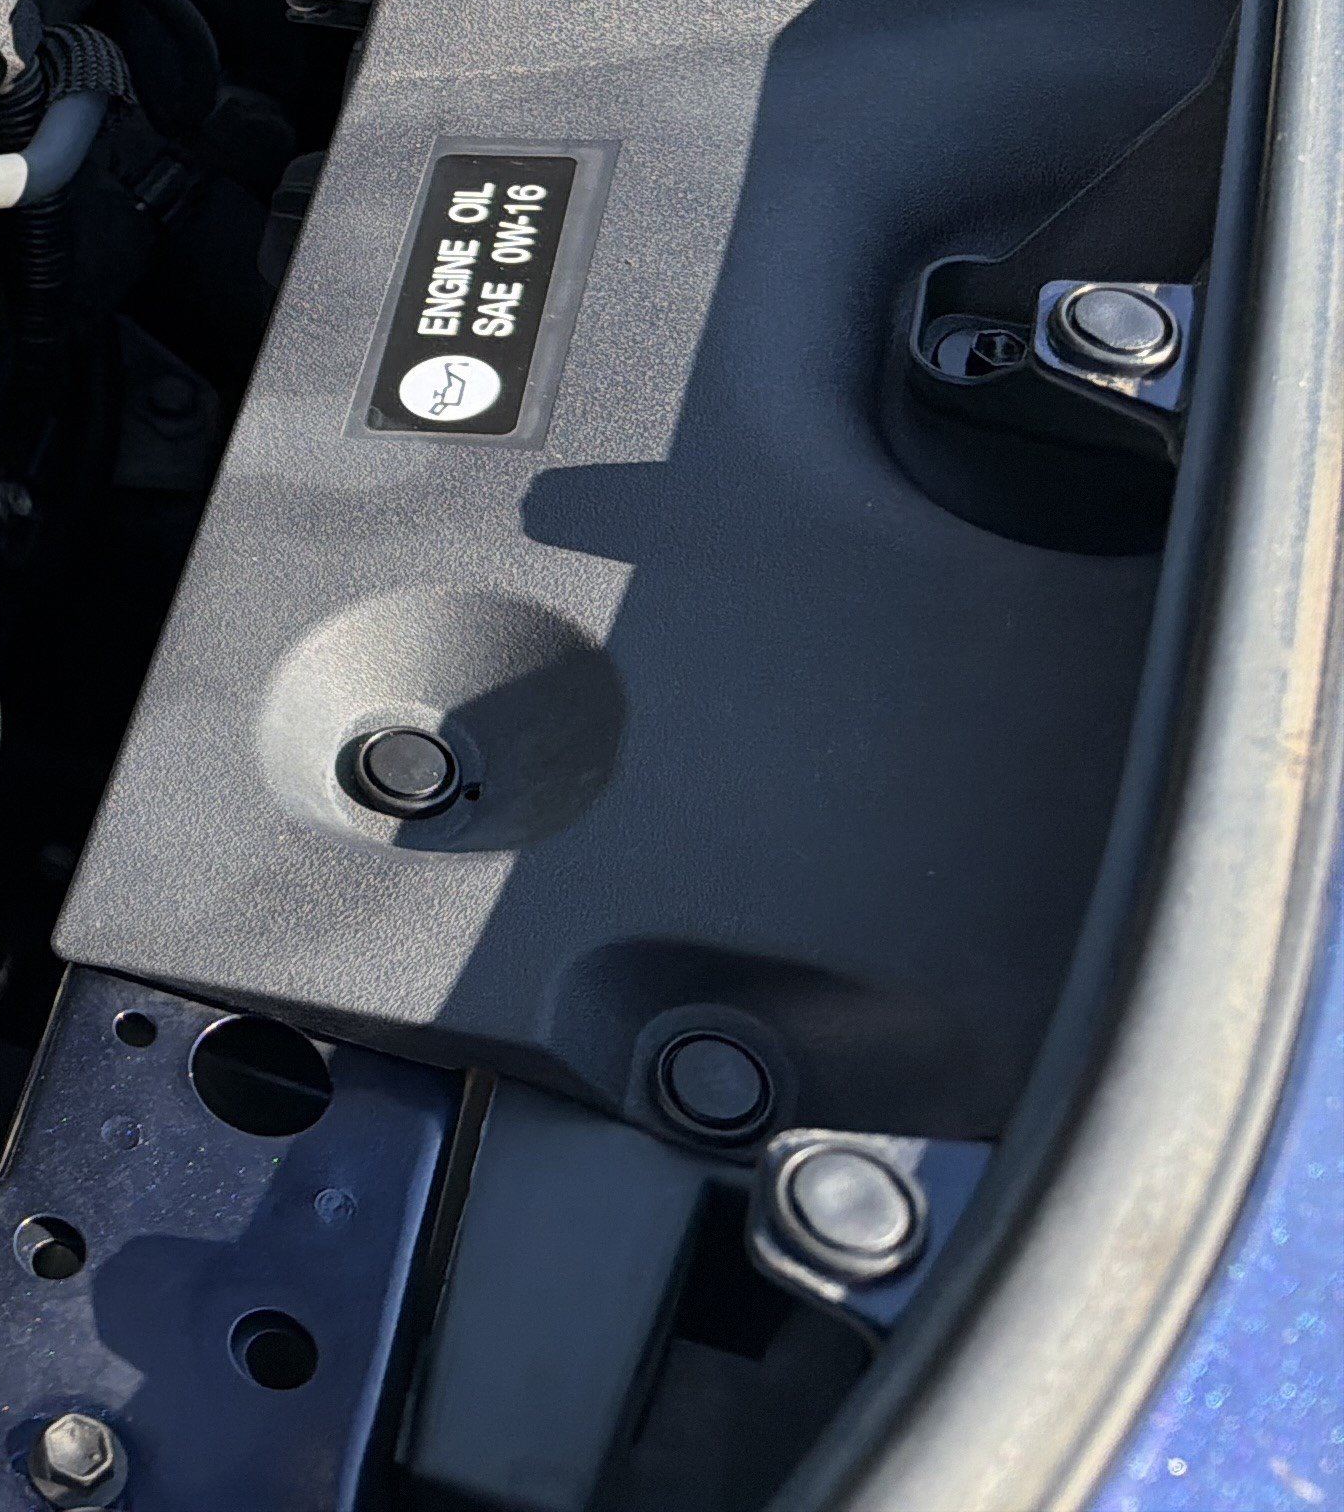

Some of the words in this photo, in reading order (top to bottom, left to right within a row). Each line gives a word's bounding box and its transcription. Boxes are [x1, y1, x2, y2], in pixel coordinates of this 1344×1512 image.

[448, 182, 496, 224] OIL
[491, 184, 547, 265] 0W-16
[417, 239, 480, 337] ENGINE
[471, 281, 524, 338] SAE
